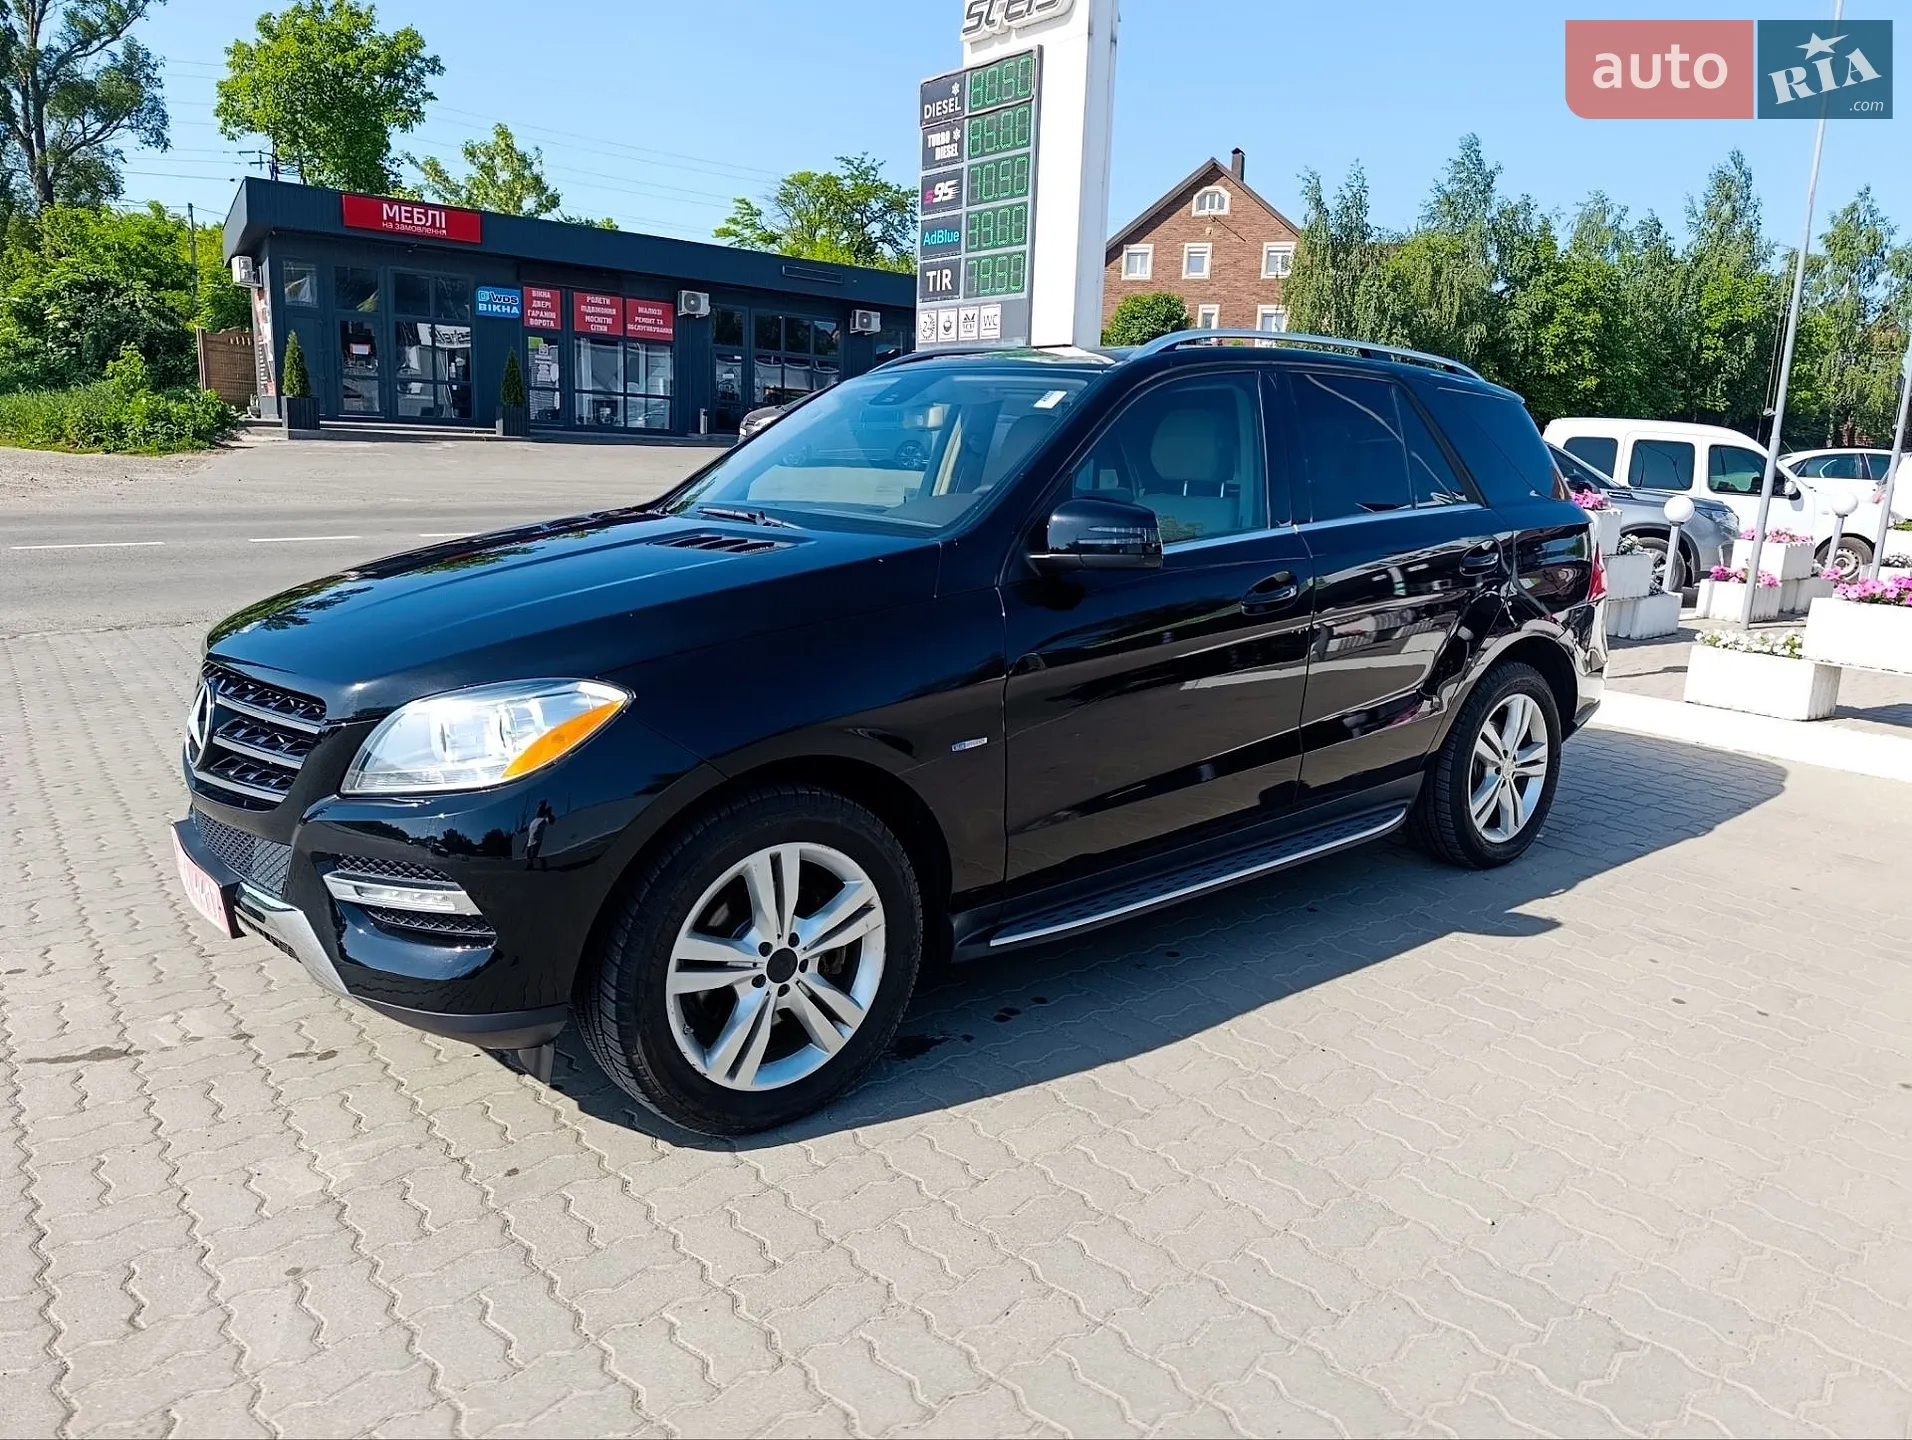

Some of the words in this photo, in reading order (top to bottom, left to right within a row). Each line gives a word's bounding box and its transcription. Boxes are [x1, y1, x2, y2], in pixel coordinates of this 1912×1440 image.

[971, 57, 1031, 108] 80.50
[923, 96, 962, 119] DIESEL
[927, 130, 950, 148] TURBO
[935, 143, 959, 161] DIESEL
[382, 203, 446, 229] МЕБЛІ
[382, 221, 393, 229] на
[395, 223, 447, 236] замовлення
[923, 230, 960, 246] AdBlue
[926, 268, 952, 292] TIR
[490, 292, 519, 304] WDS
[531, 290, 551, 298] ВІКНА
[478, 303, 520, 314] ВІКНА
[531, 300, 552, 308] ДВЕРІ
[529, 319, 555, 327] ВОРОТА
[983, 314, 998, 327] WC
